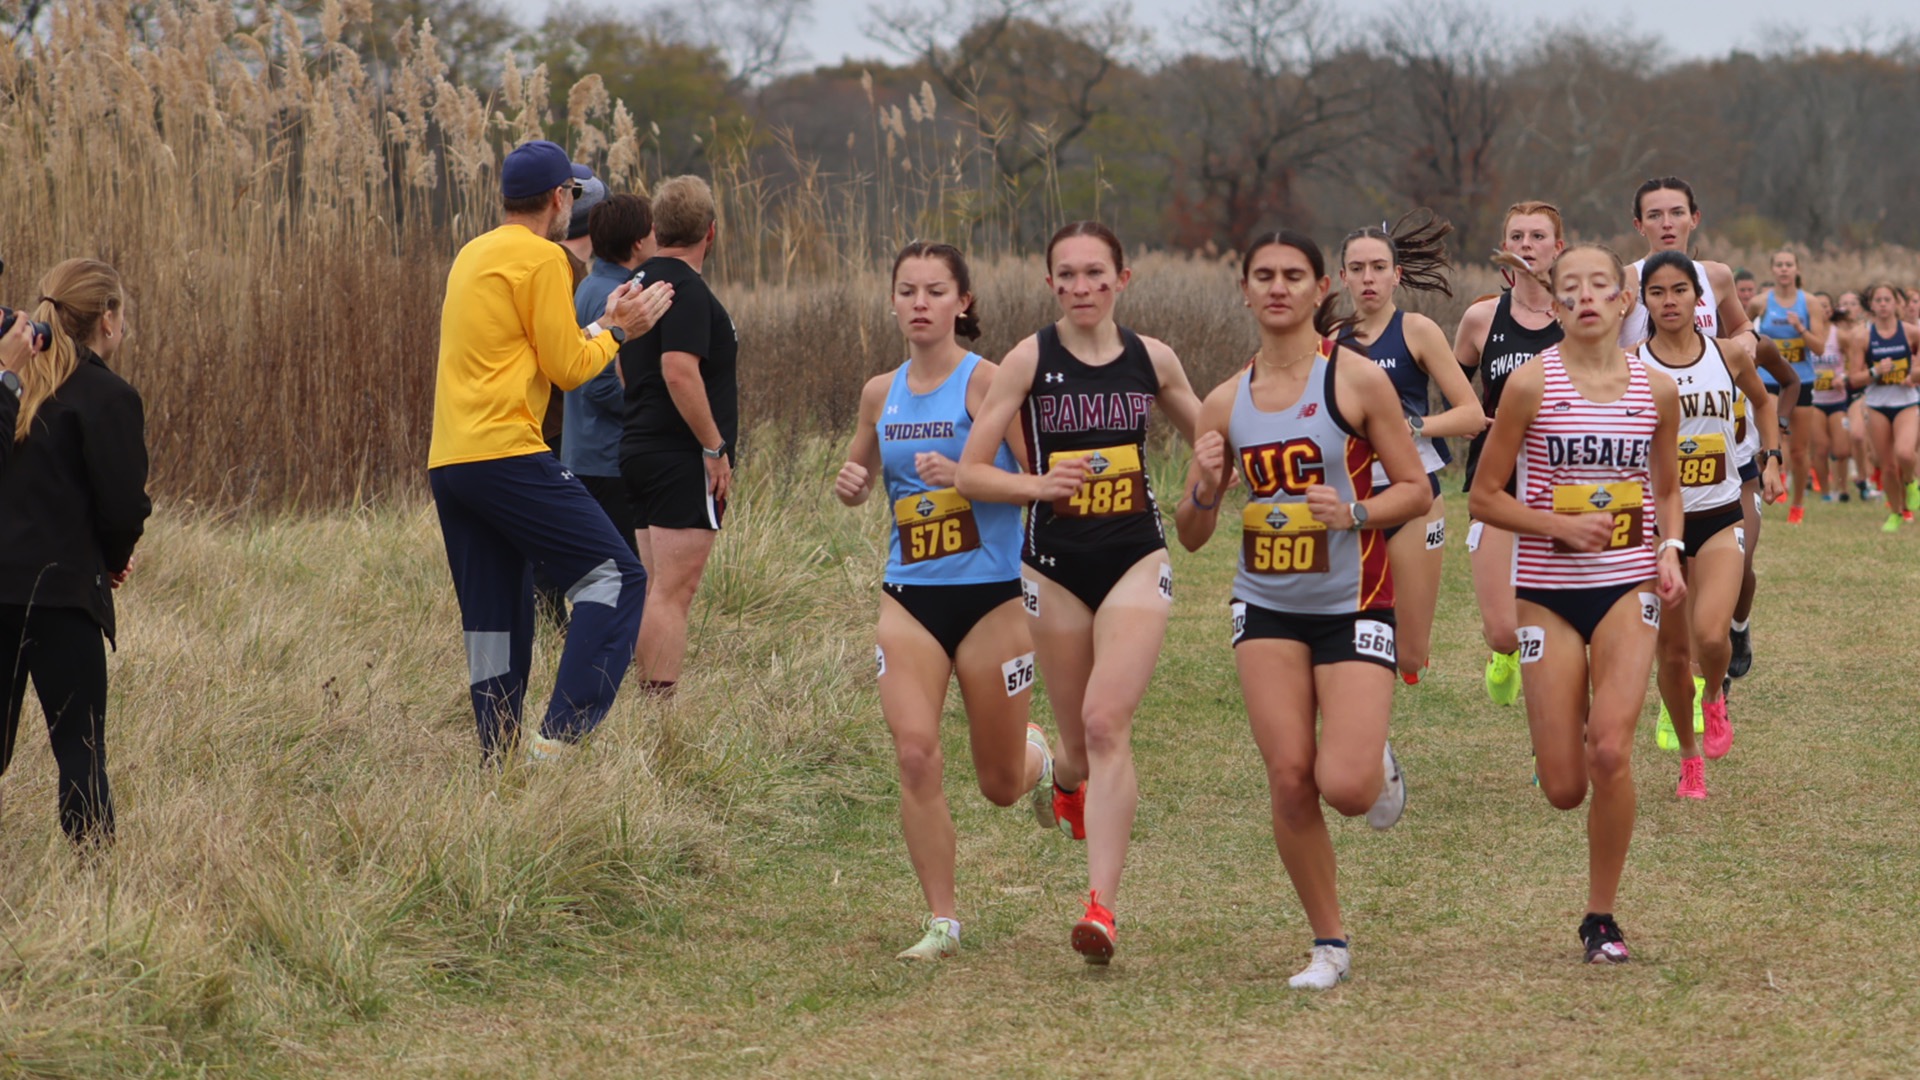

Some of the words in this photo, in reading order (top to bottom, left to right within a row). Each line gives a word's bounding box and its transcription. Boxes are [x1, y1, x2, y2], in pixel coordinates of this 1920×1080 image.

[884, 421, 955, 441] WIDENER
[1240, 436, 1325, 498] UC
[1678, 457, 1717, 484] 89
[1069, 478, 1132, 515] 482
[910, 518, 963, 559] 576
[1426, 527, 1443, 546] 45
[1254, 536, 1315, 571] 560
[1358, 633, 1394, 656] 560
[1519, 639, 1541, 658] 72
[1008, 663, 1033, 691] 576
